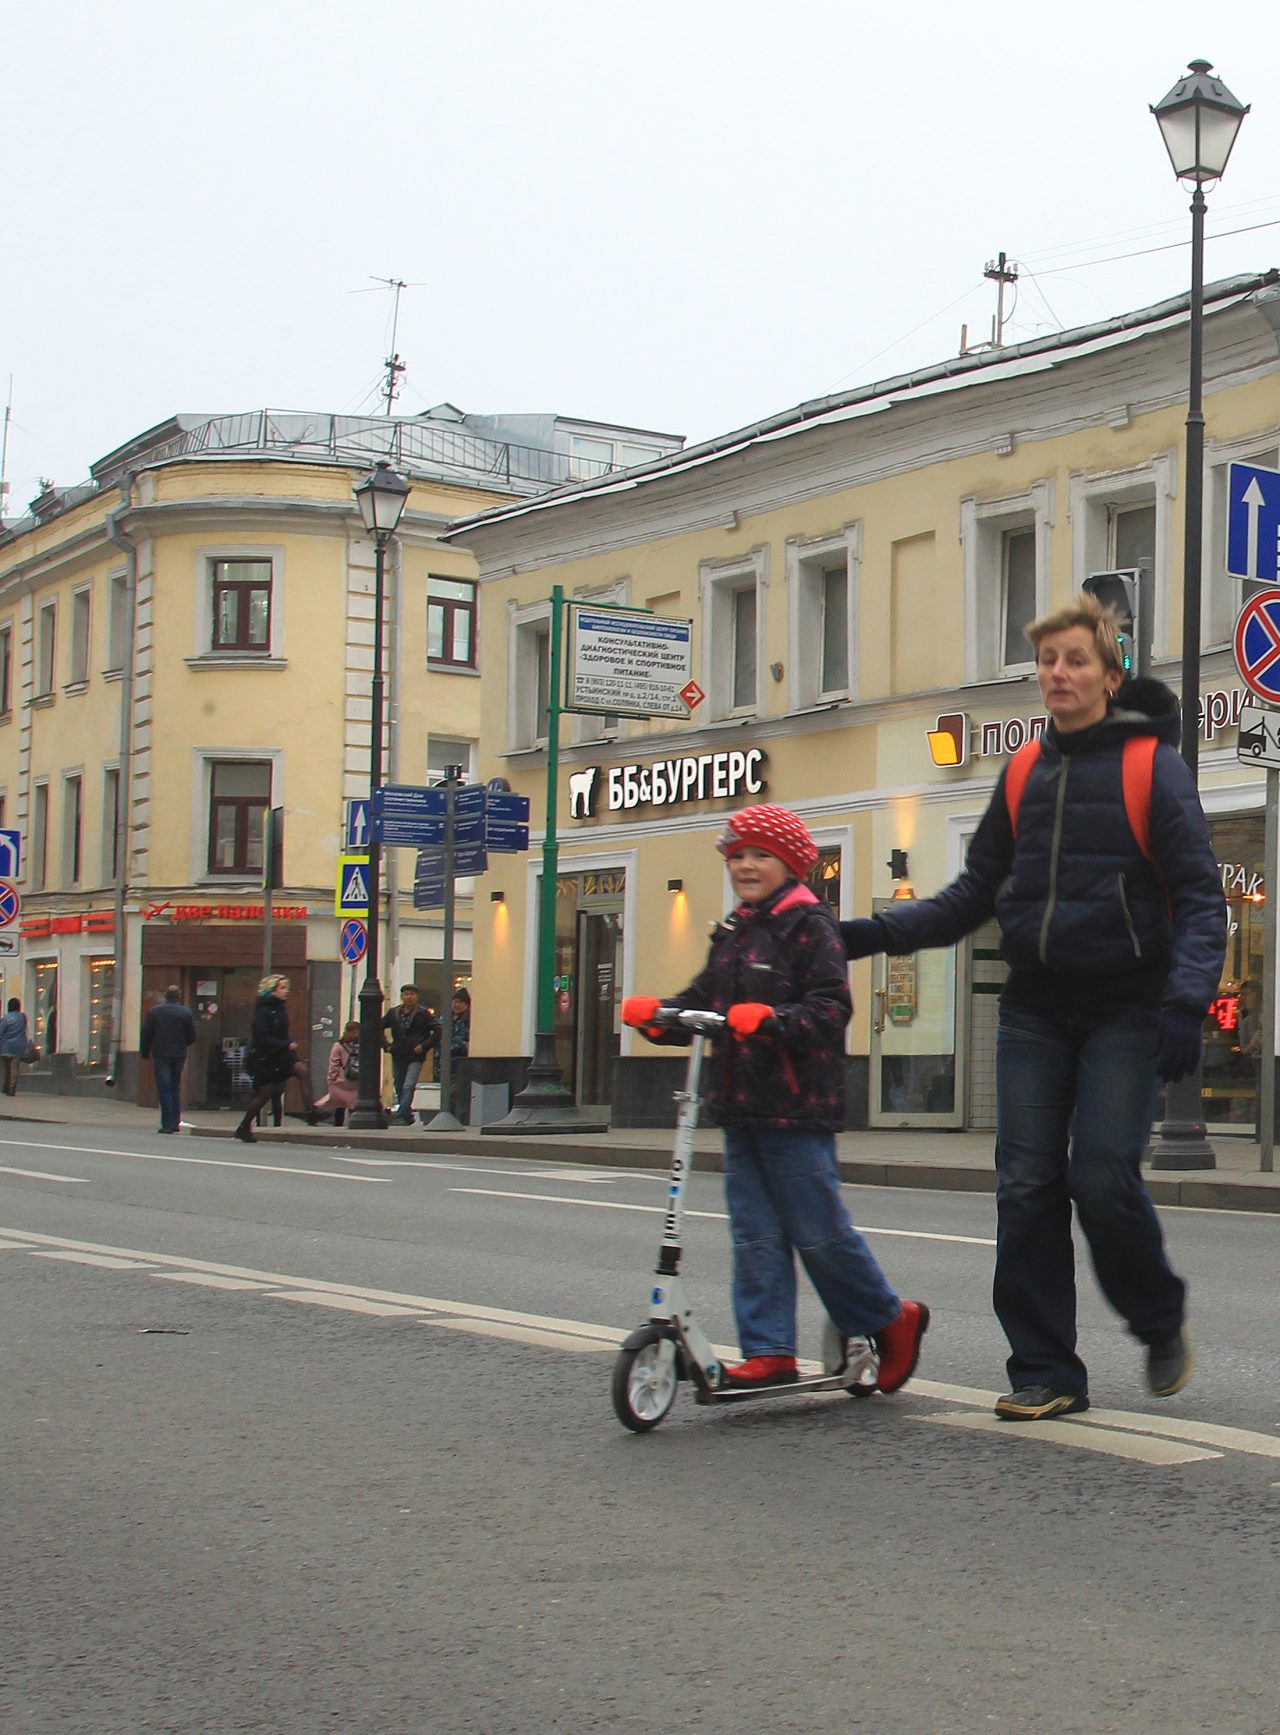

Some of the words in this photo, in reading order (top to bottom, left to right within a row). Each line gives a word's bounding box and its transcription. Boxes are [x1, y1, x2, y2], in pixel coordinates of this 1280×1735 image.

[580, 644, 658, 658] ДИАГНОСТИЧЕСКИЙ
[660, 653, 686, 662] ЦЕНТР
[598, 637, 670, 651] КОНСУЛЬТАТИВНО-
[635, 659, 687, 672] СПОРТИВНОЕ
[980, 714, 1048, 757] пол
[608, 749, 763, 811] ББ&БУРГЕРС
[1217, 863, 1264, 895] РАК
[173, 905, 213, 921] две
